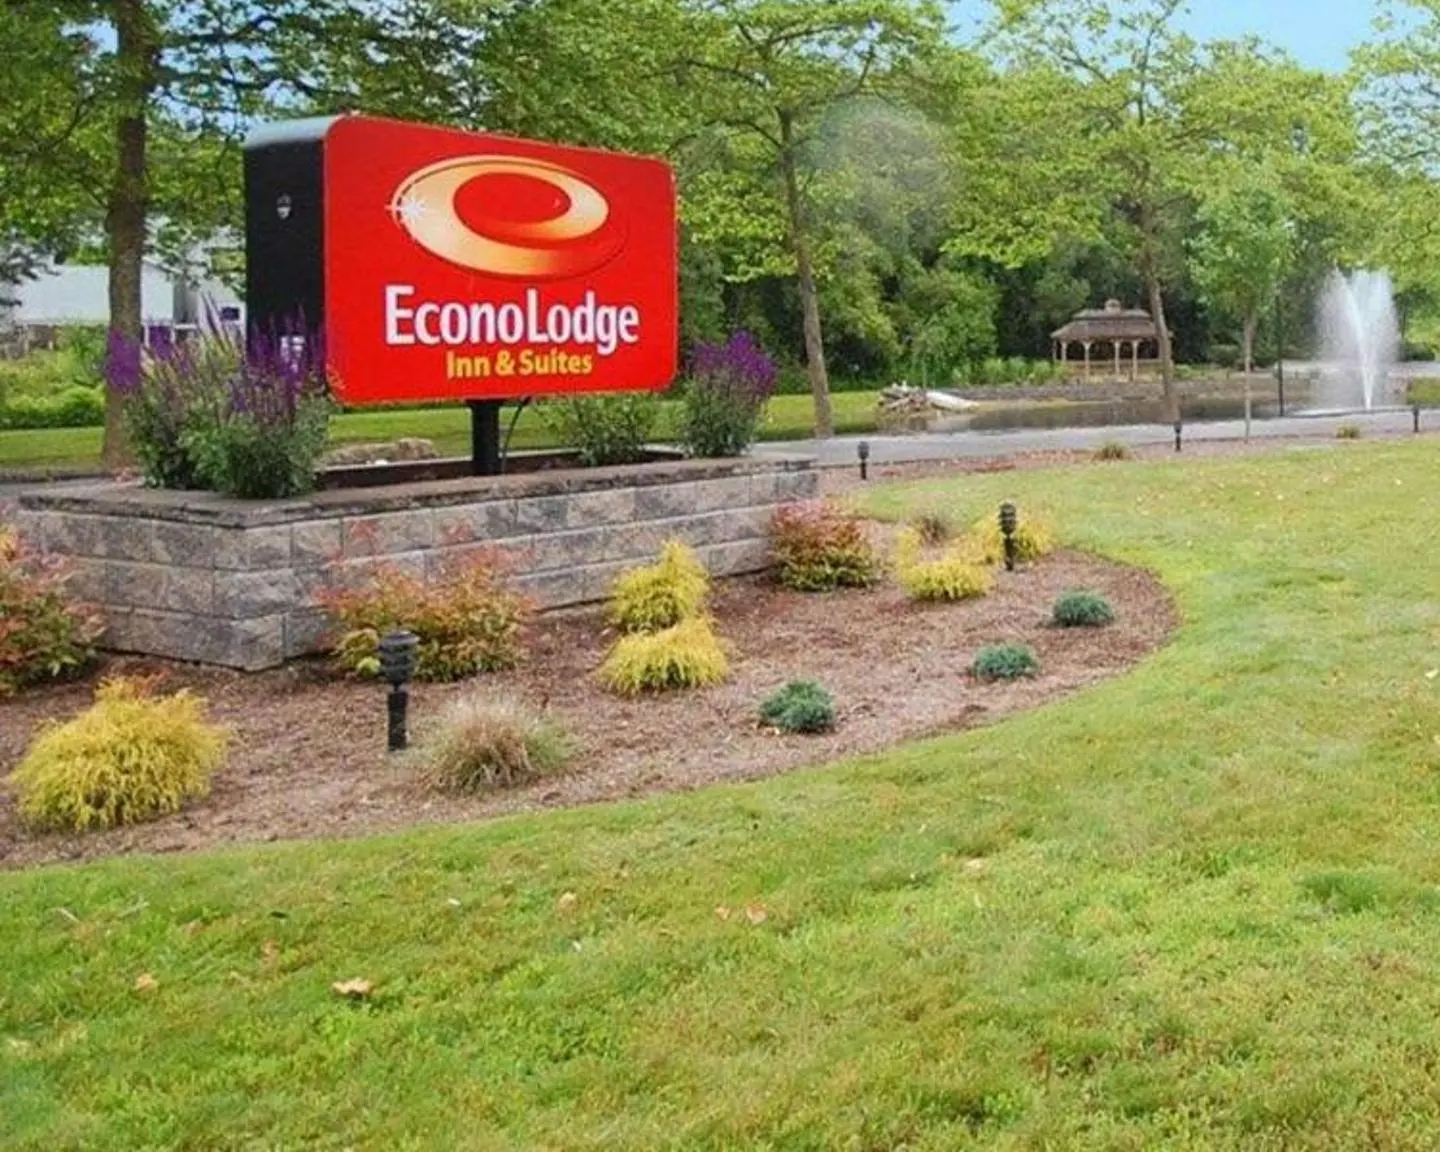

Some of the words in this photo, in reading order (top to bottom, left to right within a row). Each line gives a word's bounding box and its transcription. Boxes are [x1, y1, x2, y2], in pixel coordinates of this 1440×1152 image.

[385, 285, 639, 355] EconoLodge
[447, 351, 490, 378] Inn
[494, 349, 515, 376] &
[519, 348, 592, 376] Suites
